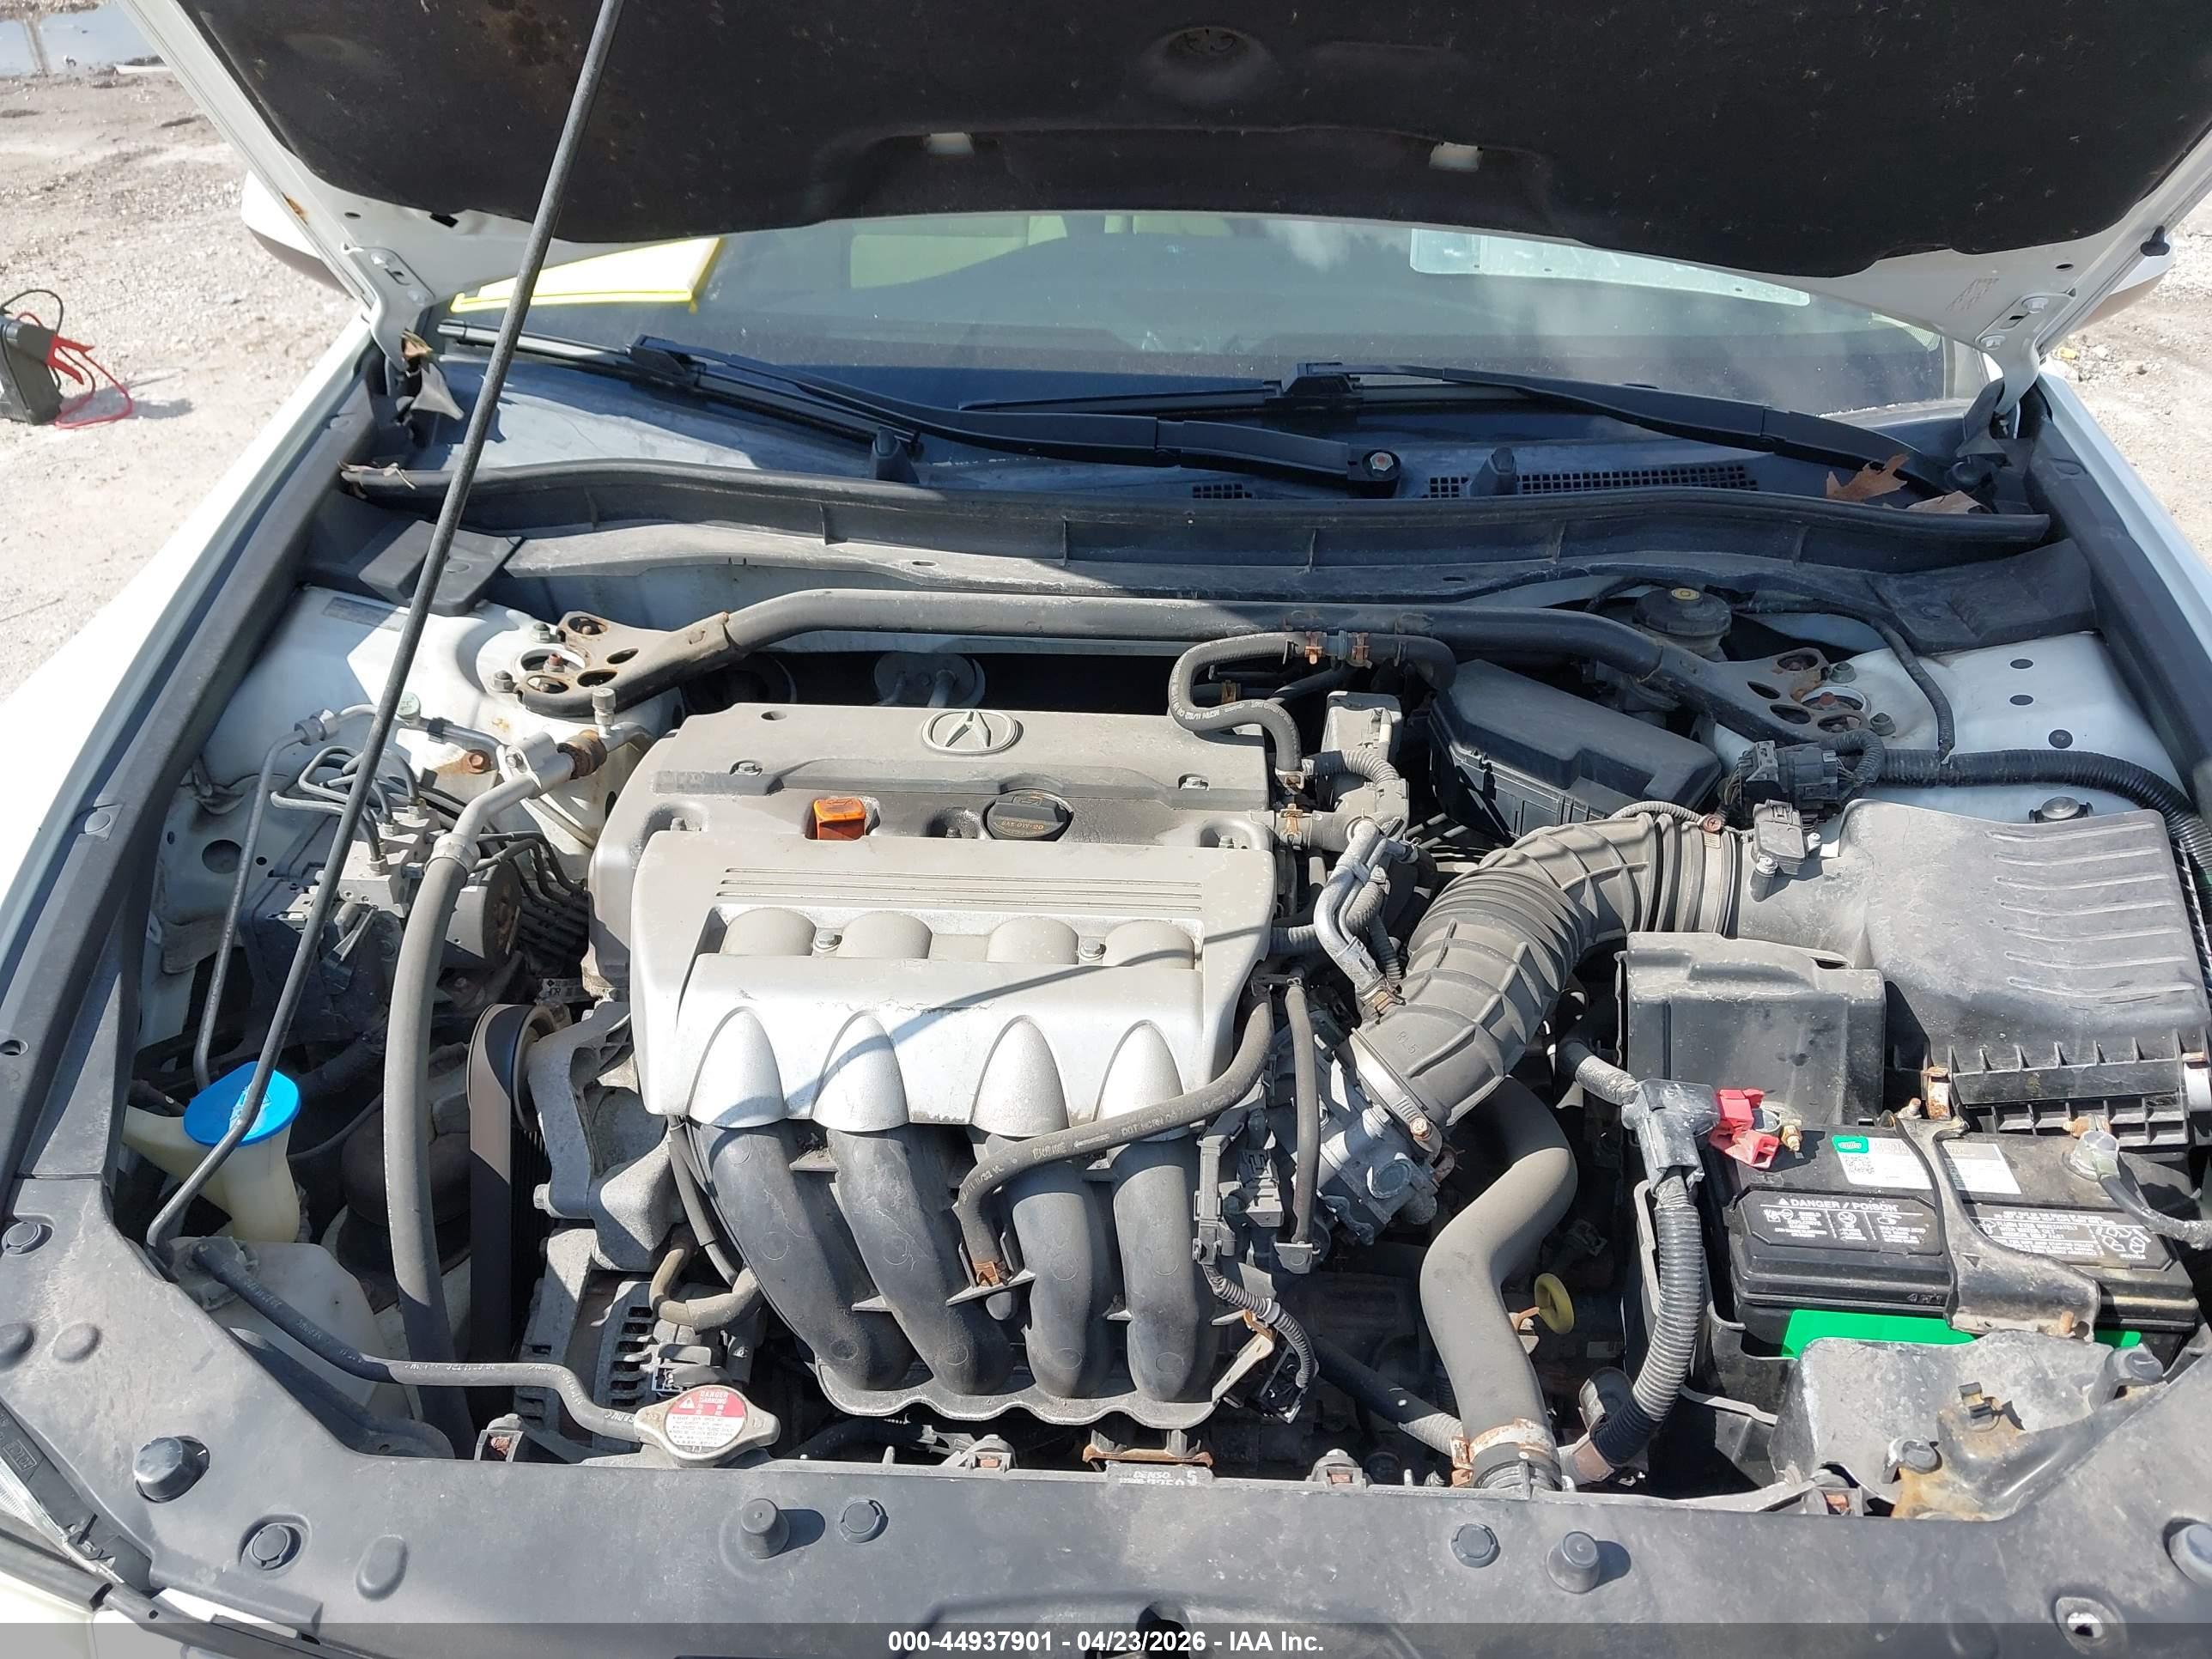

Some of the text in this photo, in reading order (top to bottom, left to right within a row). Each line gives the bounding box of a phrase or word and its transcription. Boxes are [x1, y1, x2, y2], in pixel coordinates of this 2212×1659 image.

[1016, 821, 1044, 830] 0W-20
[1790, 1198, 1840, 1209] DANGER
[1851, 1201, 1899, 1212] POISON
[1133, 1470, 1170, 1479] DENSO
